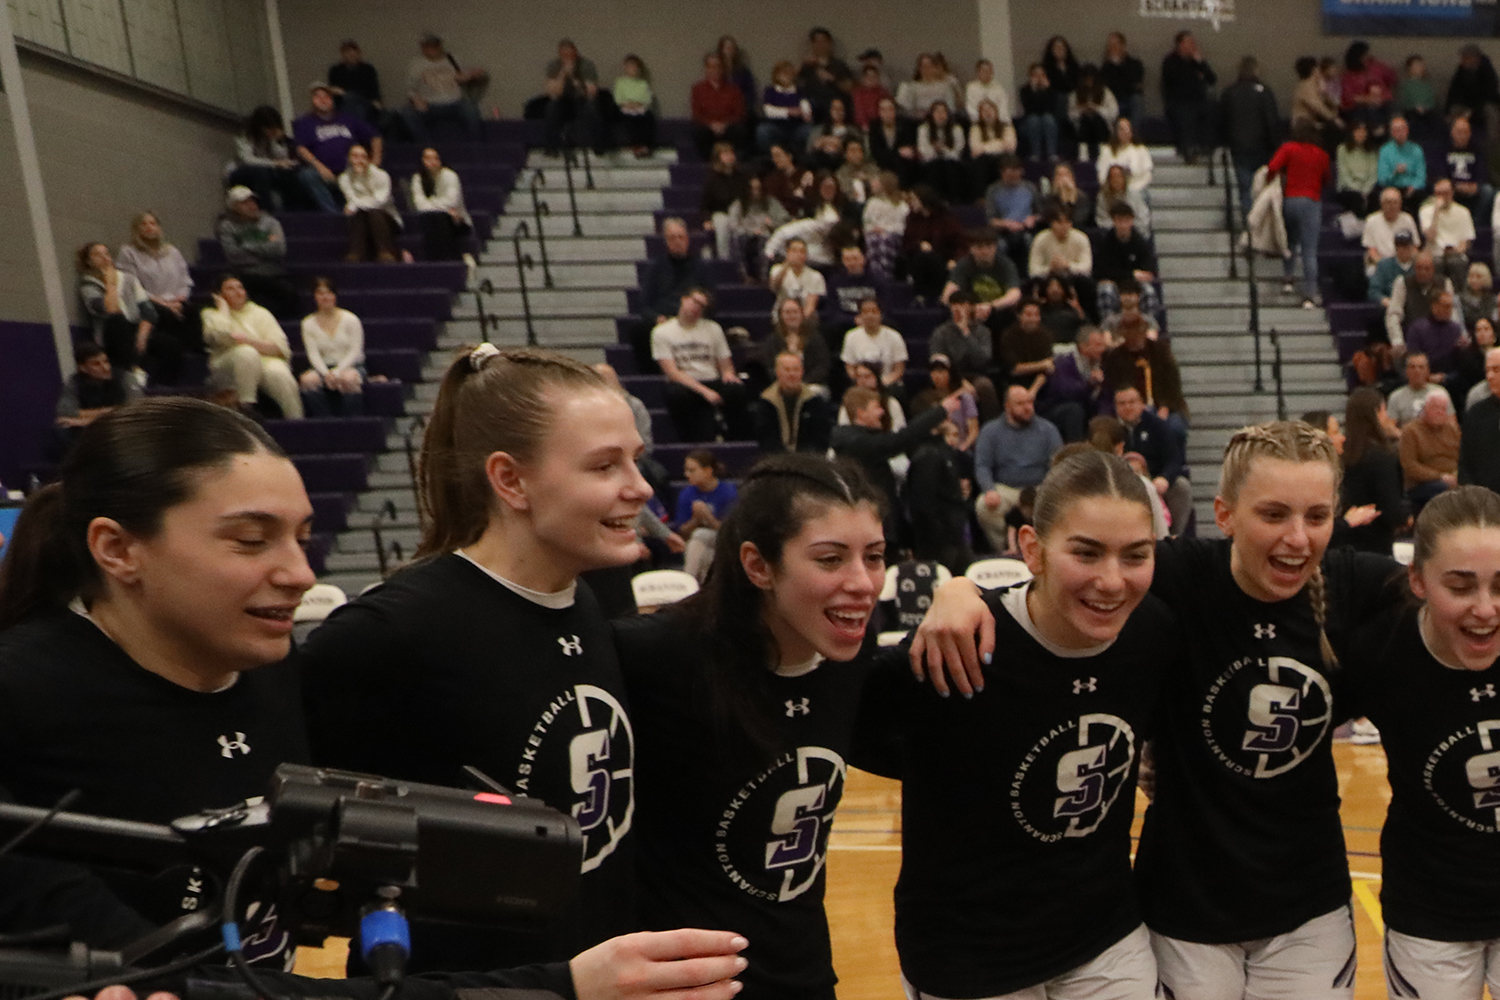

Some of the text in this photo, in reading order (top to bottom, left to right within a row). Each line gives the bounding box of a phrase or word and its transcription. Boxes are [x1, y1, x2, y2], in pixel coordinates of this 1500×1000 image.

[1010, 719, 1077, 843] SCRANTON BASKETBALL
[1422, 725, 1476, 791] BASKETBALL
[715, 842, 779, 901] SCRANTON
